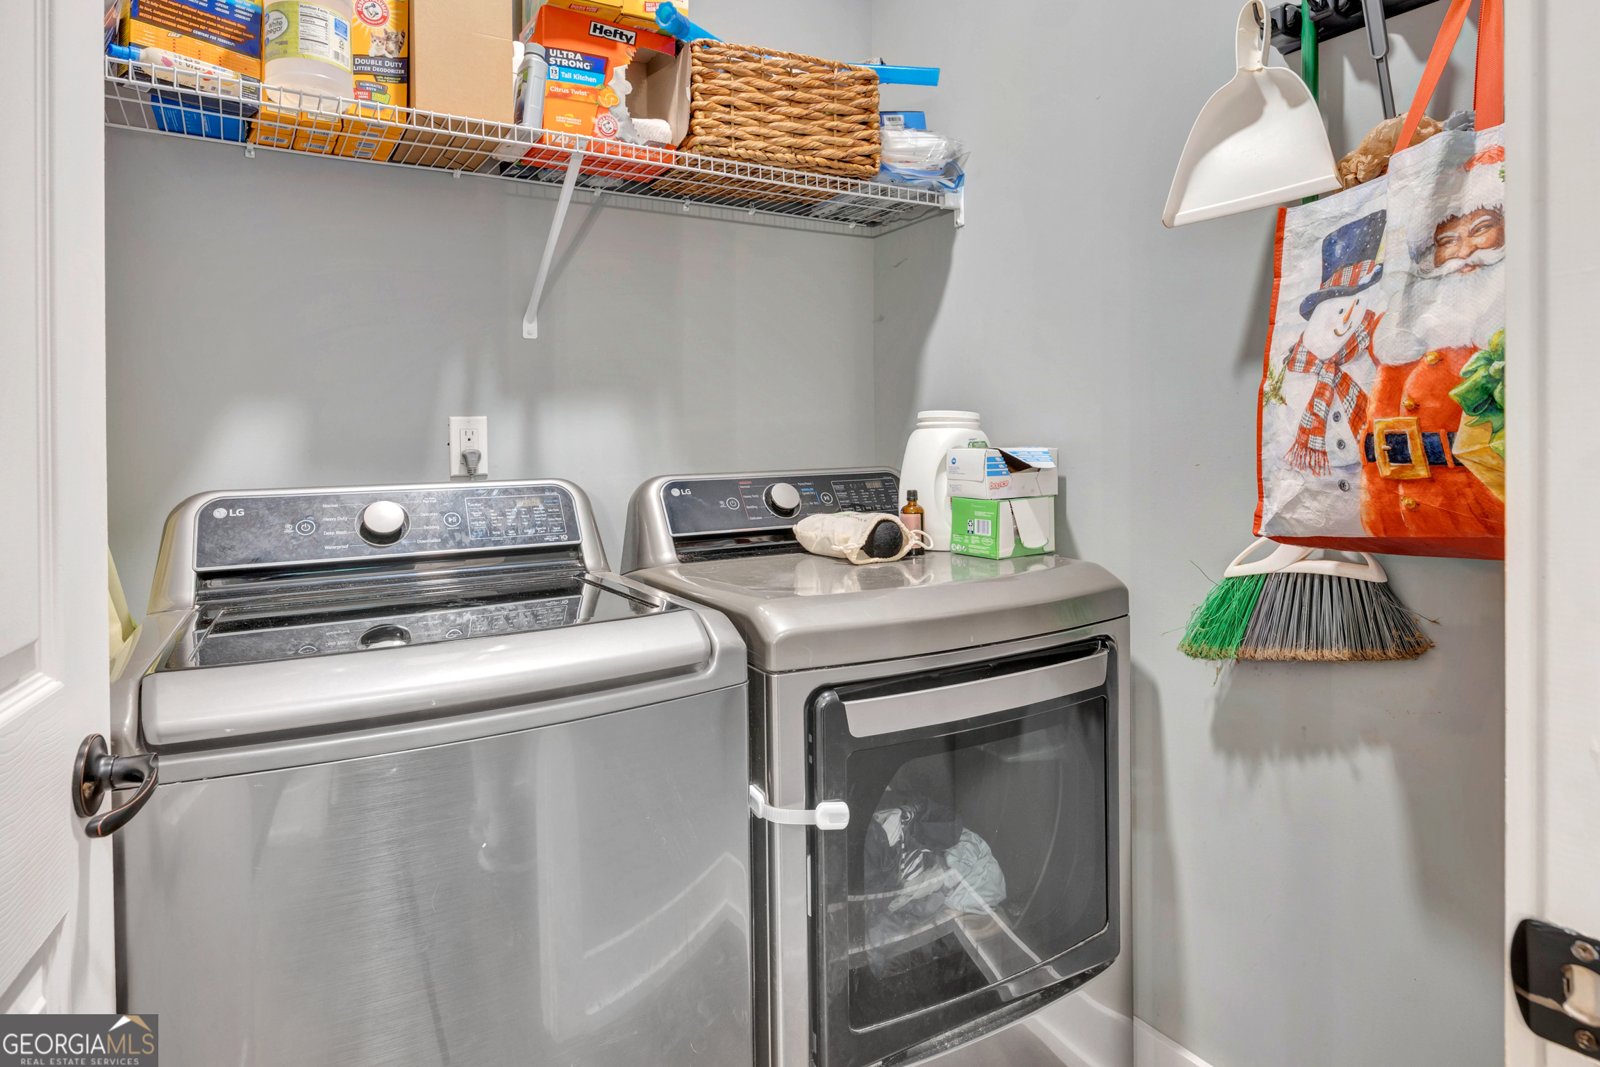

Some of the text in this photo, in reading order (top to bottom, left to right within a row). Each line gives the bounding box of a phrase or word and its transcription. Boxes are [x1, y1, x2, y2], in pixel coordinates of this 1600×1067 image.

[592, 23, 634, 43] Hefty
[549, 49, 582, 60] ULTRA
[549, 57, 591, 70] STRONG
[573, 74, 597, 83] Kitchen
